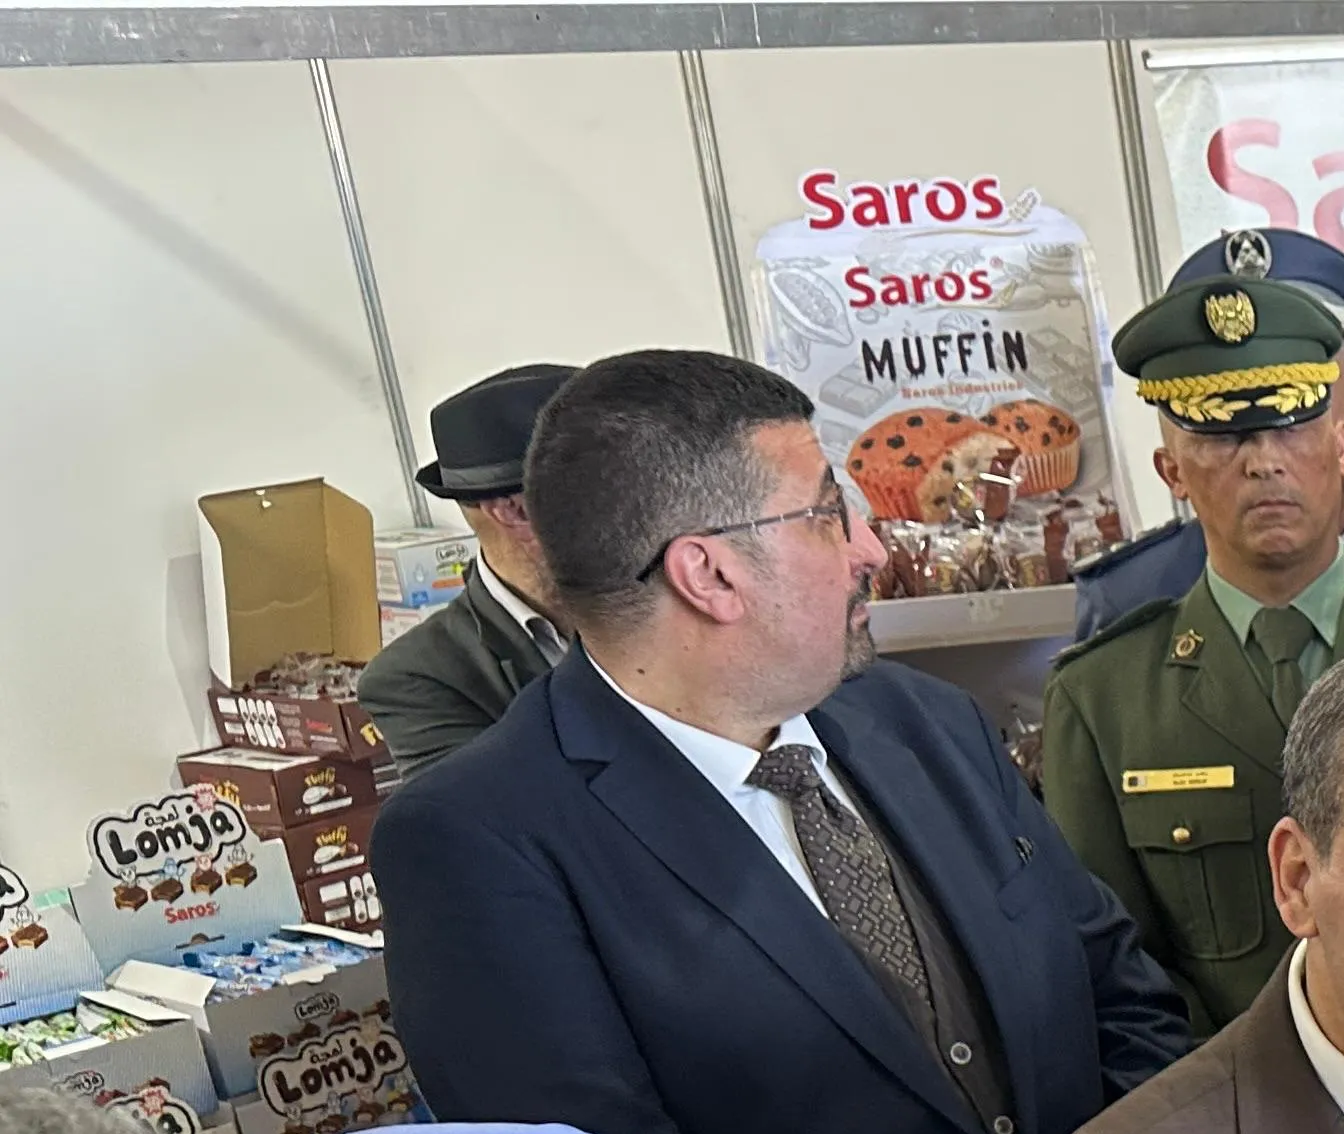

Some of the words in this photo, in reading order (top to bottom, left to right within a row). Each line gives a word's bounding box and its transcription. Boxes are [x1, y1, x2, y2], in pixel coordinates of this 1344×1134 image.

[803, 173, 1003, 230] Saros
[844, 266, 993, 309] Saros
[109, 804, 235, 865] Lomja
[163, 901, 217, 925] Saros
[274, 1037, 398, 1104] Lomja
